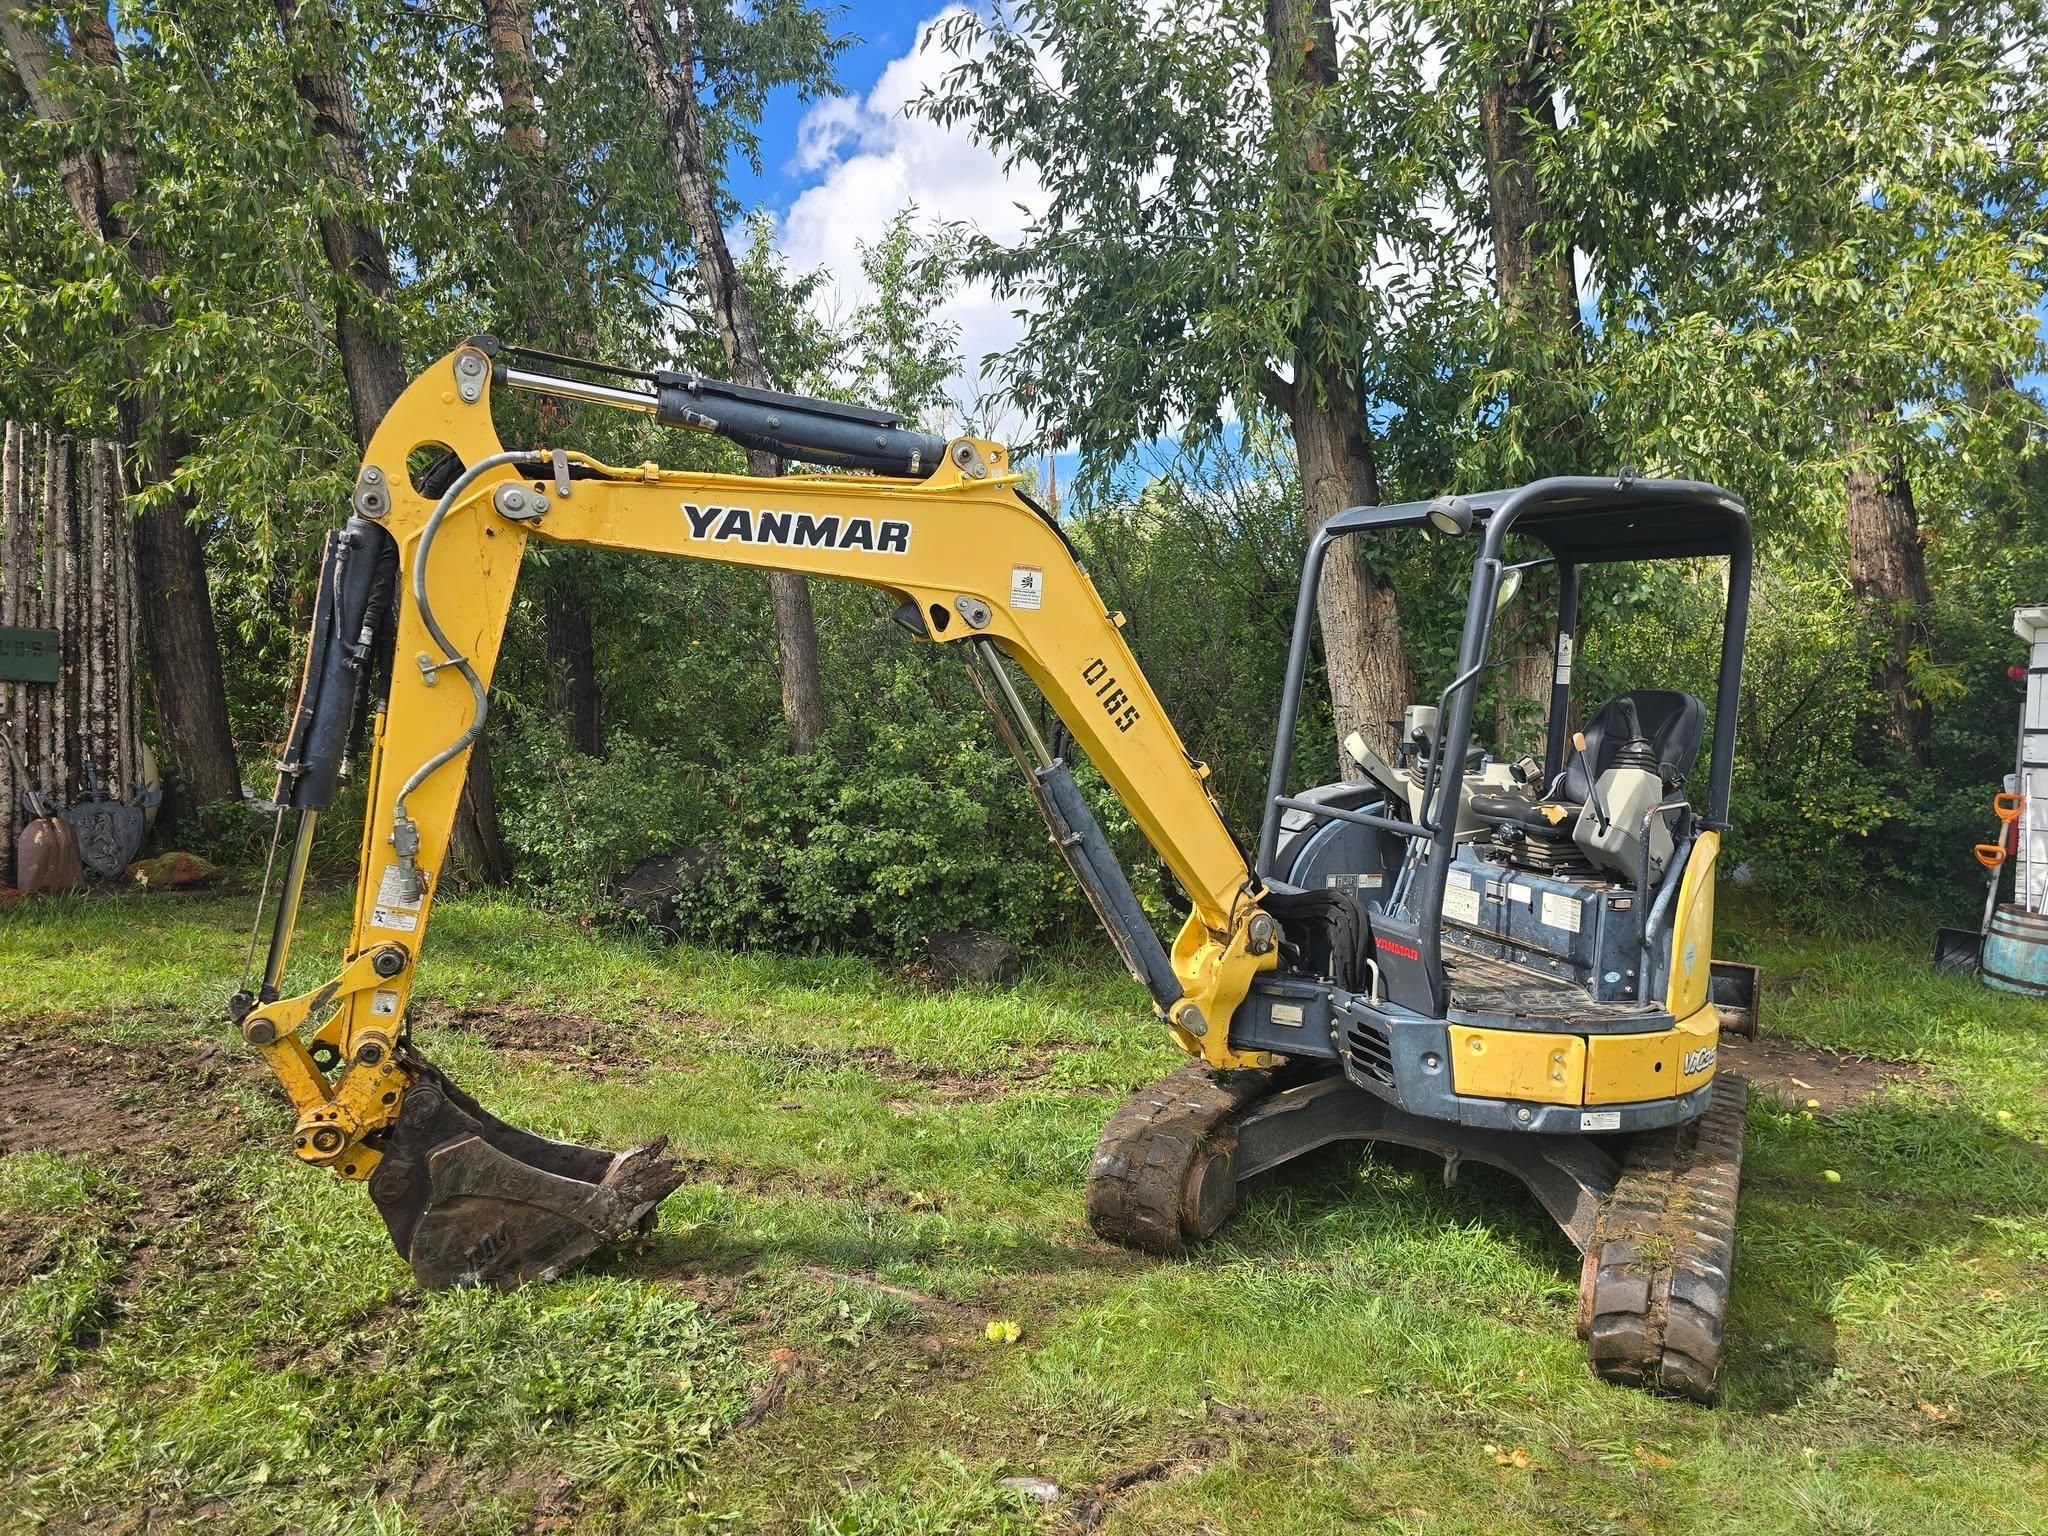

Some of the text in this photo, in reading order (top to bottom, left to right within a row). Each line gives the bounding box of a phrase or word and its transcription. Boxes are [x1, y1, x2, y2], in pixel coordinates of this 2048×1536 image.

[683, 504, 911, 553] YANMAR
[1082, 658, 1141, 733] 0165
[1375, 937, 1418, 960] YANMAR
